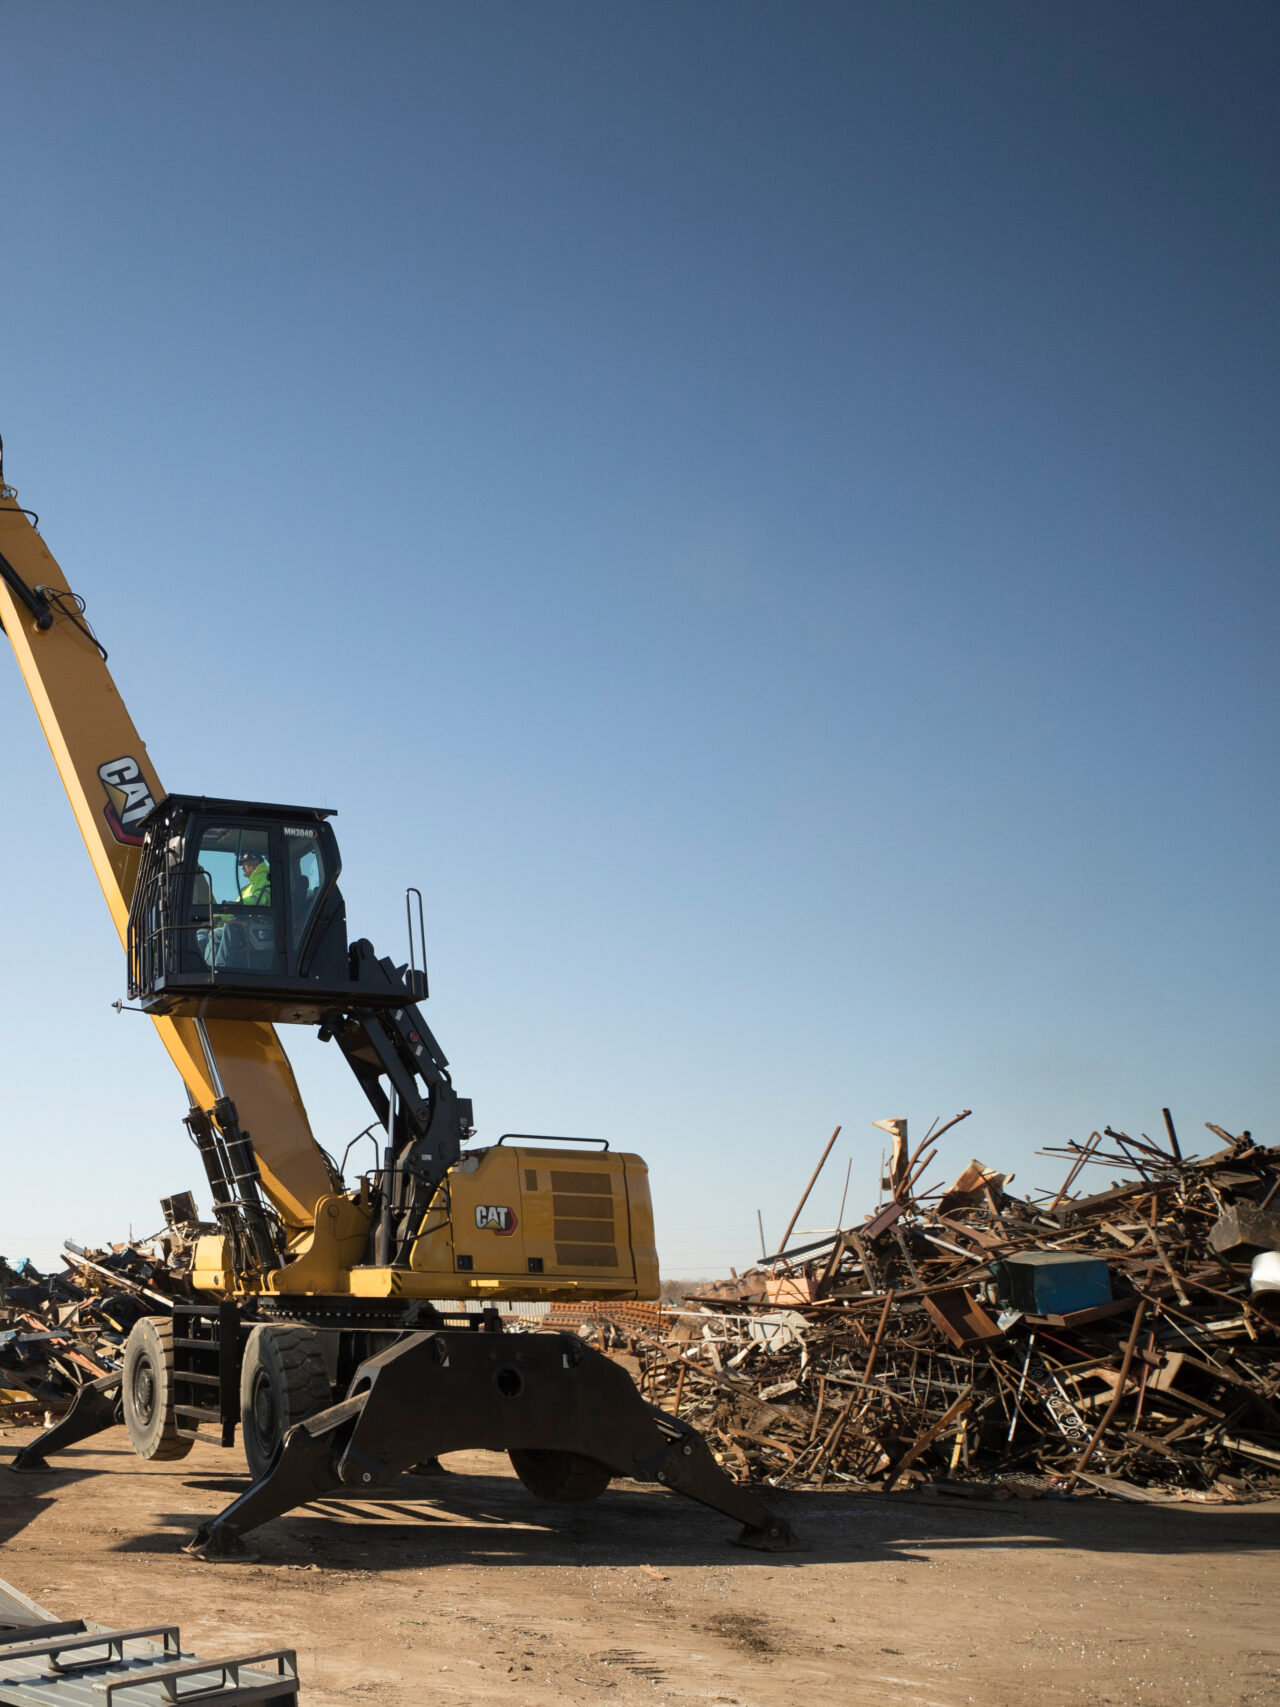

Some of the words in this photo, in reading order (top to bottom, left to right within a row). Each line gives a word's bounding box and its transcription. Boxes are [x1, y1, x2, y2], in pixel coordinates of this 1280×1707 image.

[99, 757, 156, 825] CAT
[284, 827, 314, 838] MH3040
[476, 1206, 508, 1229] CAT
